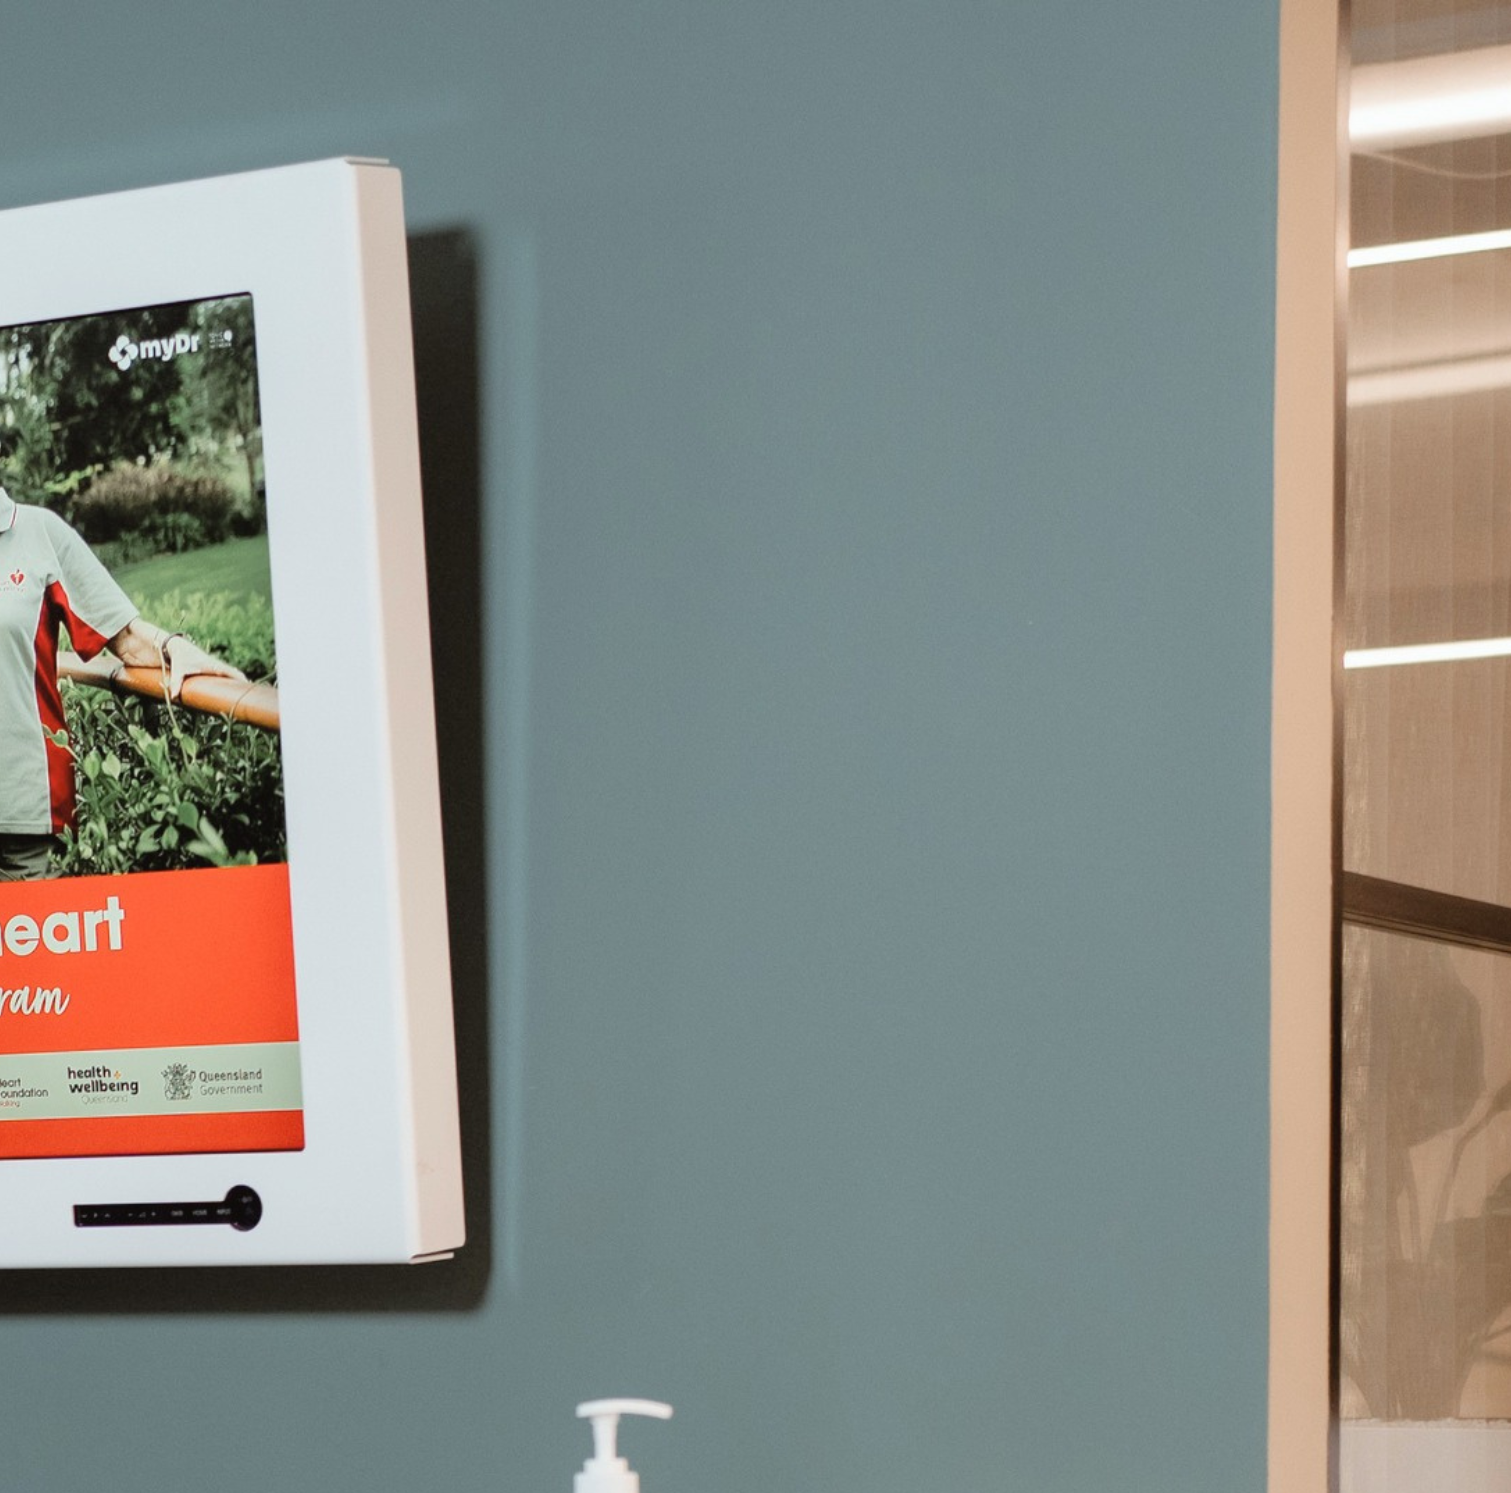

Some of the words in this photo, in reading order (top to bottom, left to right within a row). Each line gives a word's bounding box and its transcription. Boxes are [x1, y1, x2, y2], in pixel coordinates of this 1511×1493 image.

[140, 334, 199, 362] myDr
[68, 1066, 111, 1079] health
[199, 1069, 263, 1082] Queensland
[69, 1078, 139, 1095] wellbeing
[200, 1083, 264, 1096] Government
